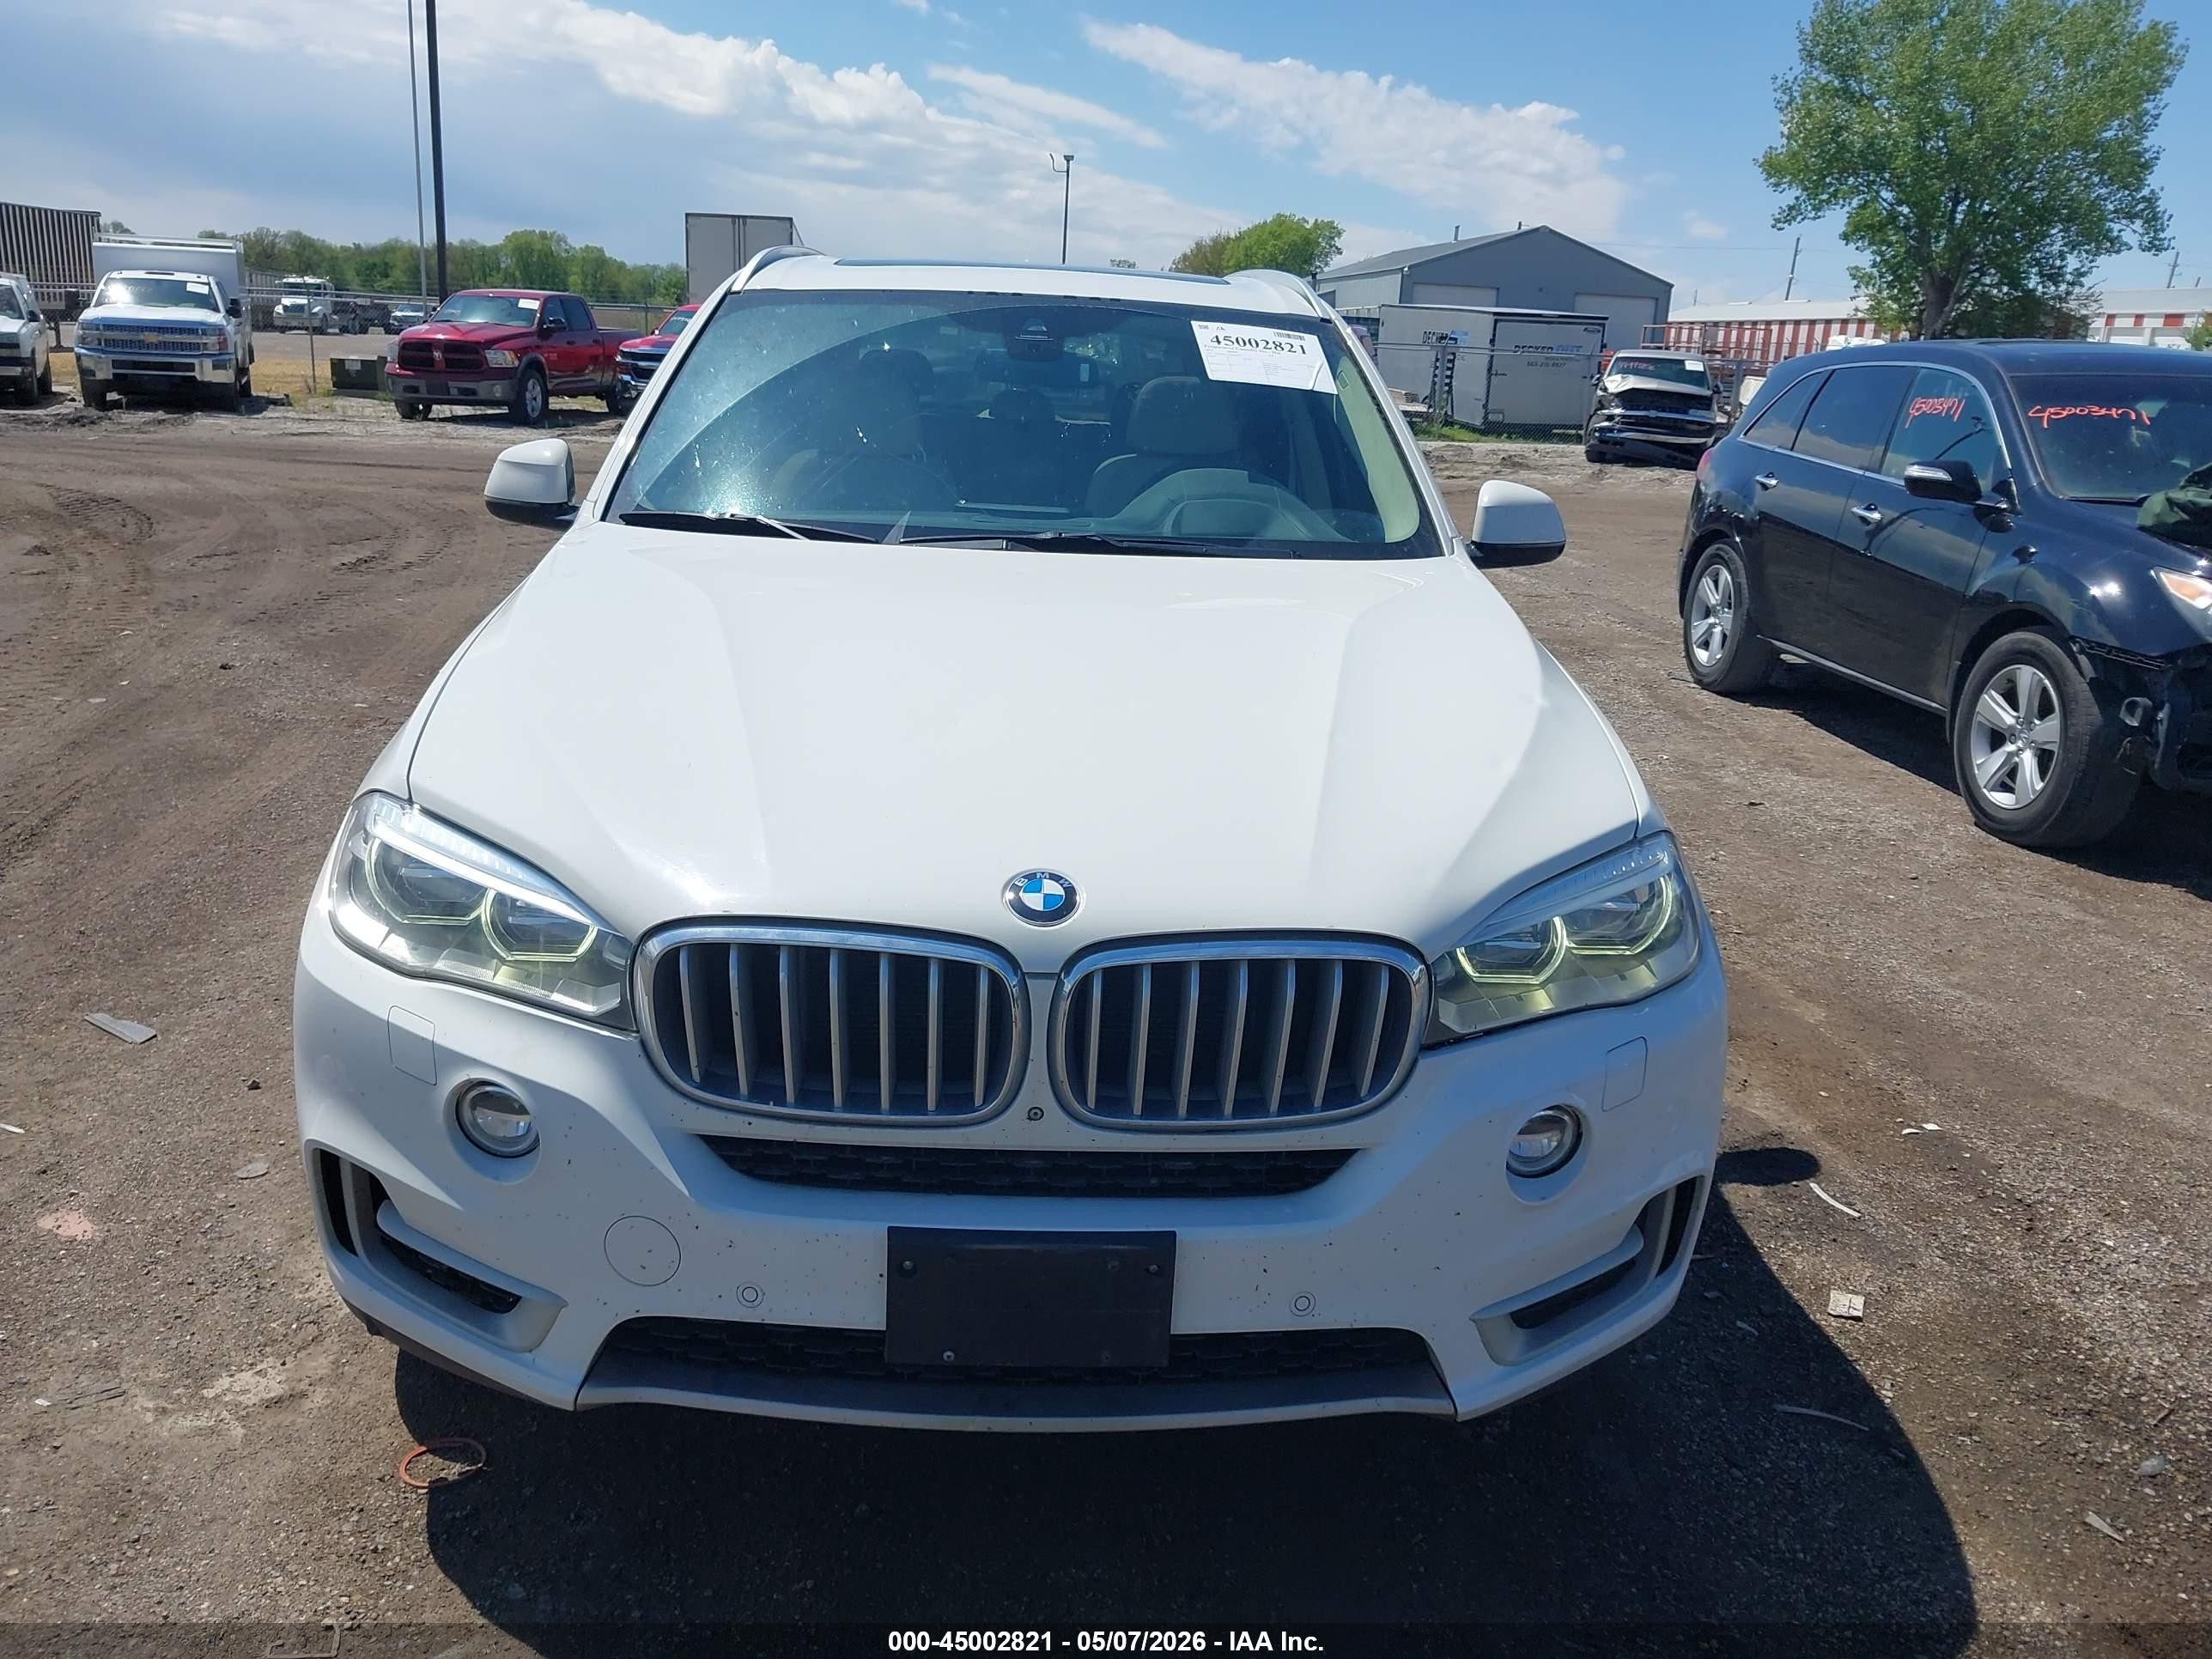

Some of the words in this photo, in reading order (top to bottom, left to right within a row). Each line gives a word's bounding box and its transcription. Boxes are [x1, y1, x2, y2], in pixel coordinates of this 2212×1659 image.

[1210, 334, 1307, 355] 45002821
[2027, 404, 2151, 429] 45003471
[1014, 872, 1073, 889] BMW
